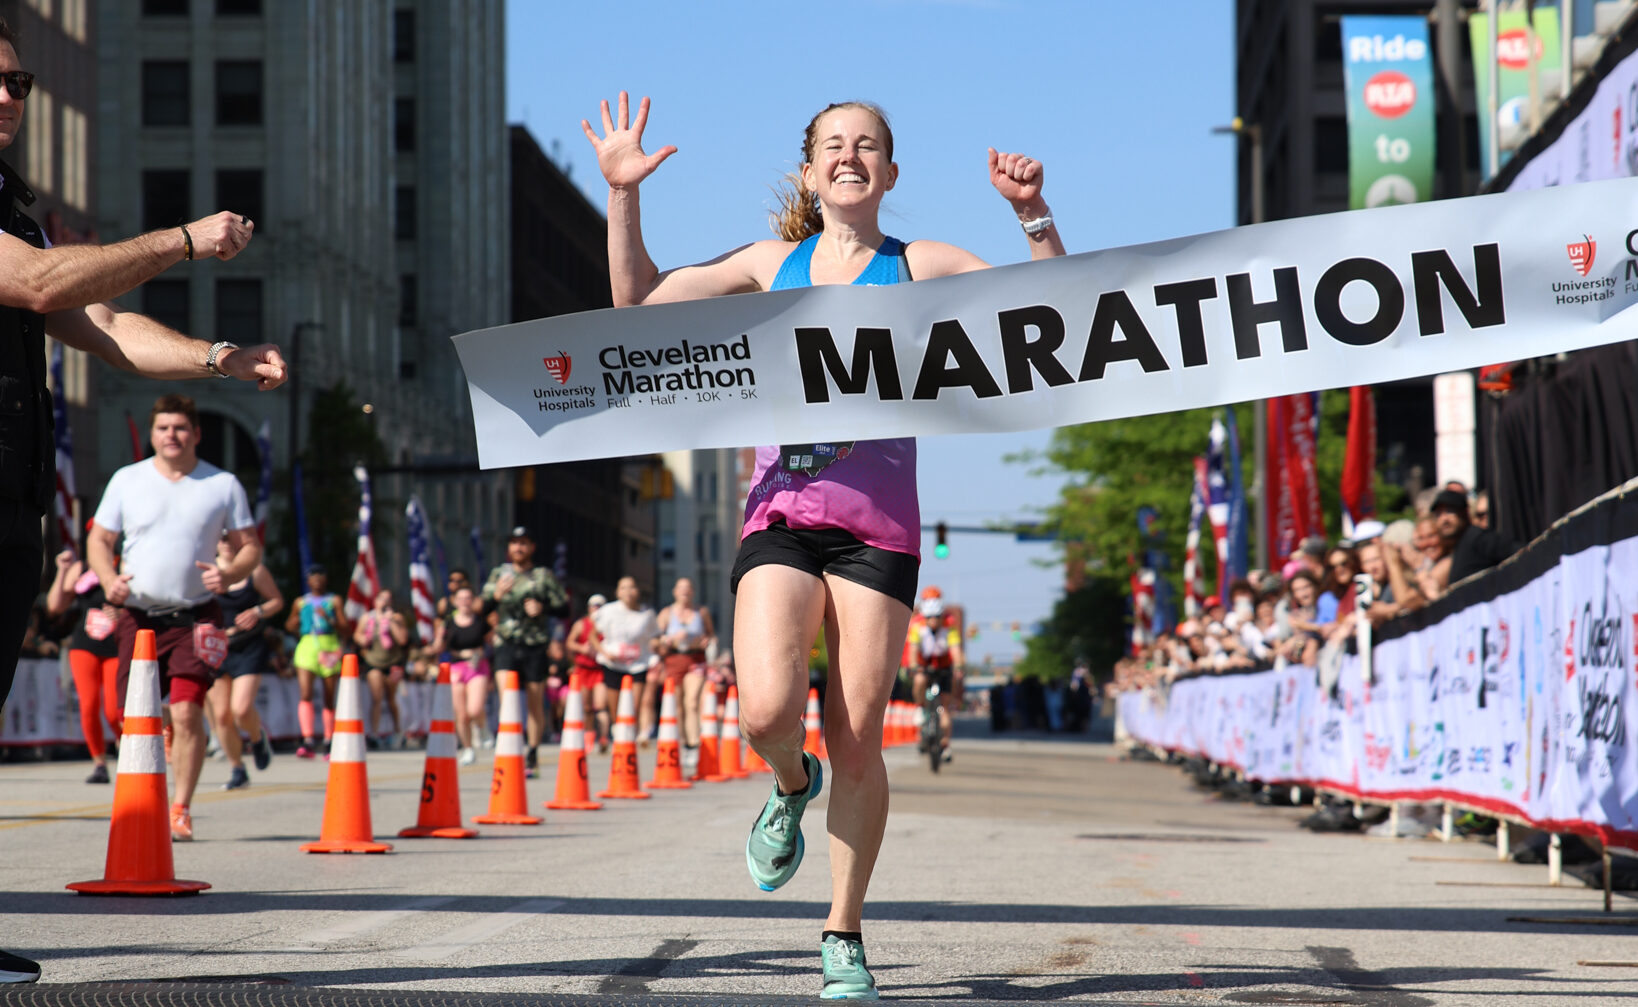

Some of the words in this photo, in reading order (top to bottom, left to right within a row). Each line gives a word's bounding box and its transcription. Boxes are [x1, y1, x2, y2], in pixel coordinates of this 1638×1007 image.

[1350, 36, 1425, 62] Ride
[1374, 135, 1410, 162] to
[1552, 277, 1617, 292] University
[1556, 289, 1615, 305] Hospitals
[794, 242, 1506, 404] MARATHON
[599, 335, 751, 369] Cleveland
[603, 364, 756, 395] Marathon
[533, 385, 596, 399] University
[607, 397, 631, 408] Full
[650, 394, 677, 406] Half
[695, 391, 721, 403] 10K
[740, 388, 758, 400] 5K
[539, 397, 596, 412] Hospitals
[815, 444, 831, 453] Elite
